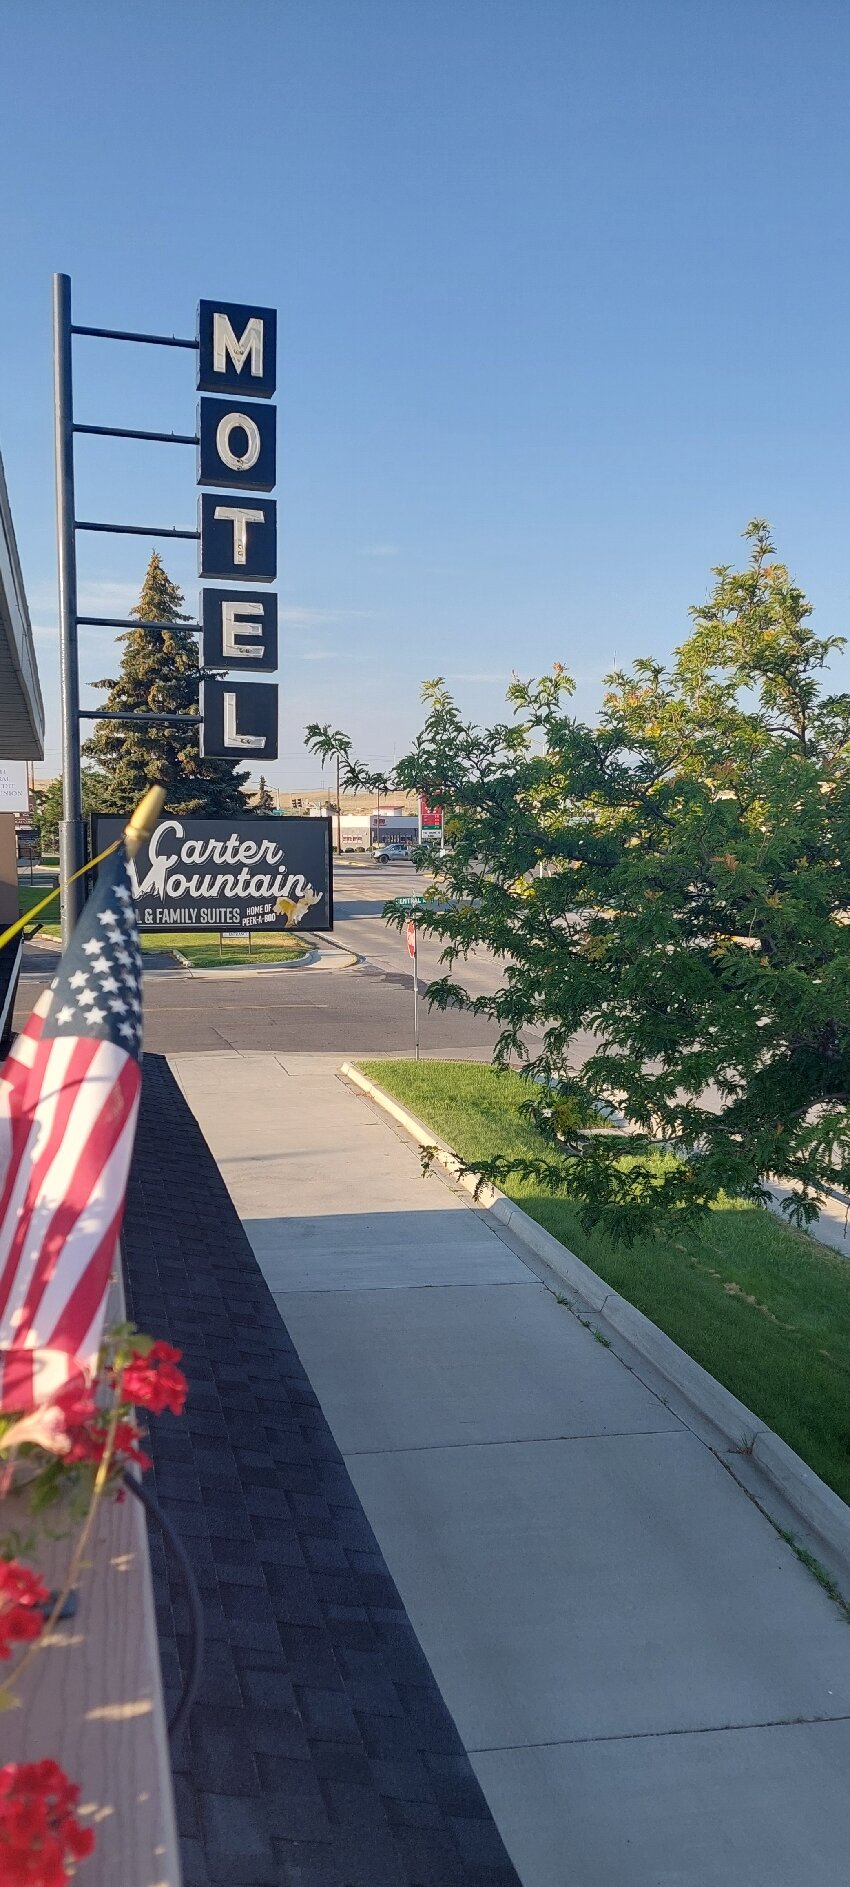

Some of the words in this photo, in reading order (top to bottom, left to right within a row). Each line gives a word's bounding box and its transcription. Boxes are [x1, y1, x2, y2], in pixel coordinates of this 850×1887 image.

[212, 311, 267, 749] MOTEL
[148, 820, 285, 867] Carter
[131, 855, 310, 903] Mountain
[144, 908, 154, 924] &
[156, 908, 198, 924] FAMILY
[200, 907, 241, 924] SUITES
[242, 912, 276, 927] PEEK-A-BOO
[246, 905, 264, 916] HOME
[264, 903, 273, 913] OF
